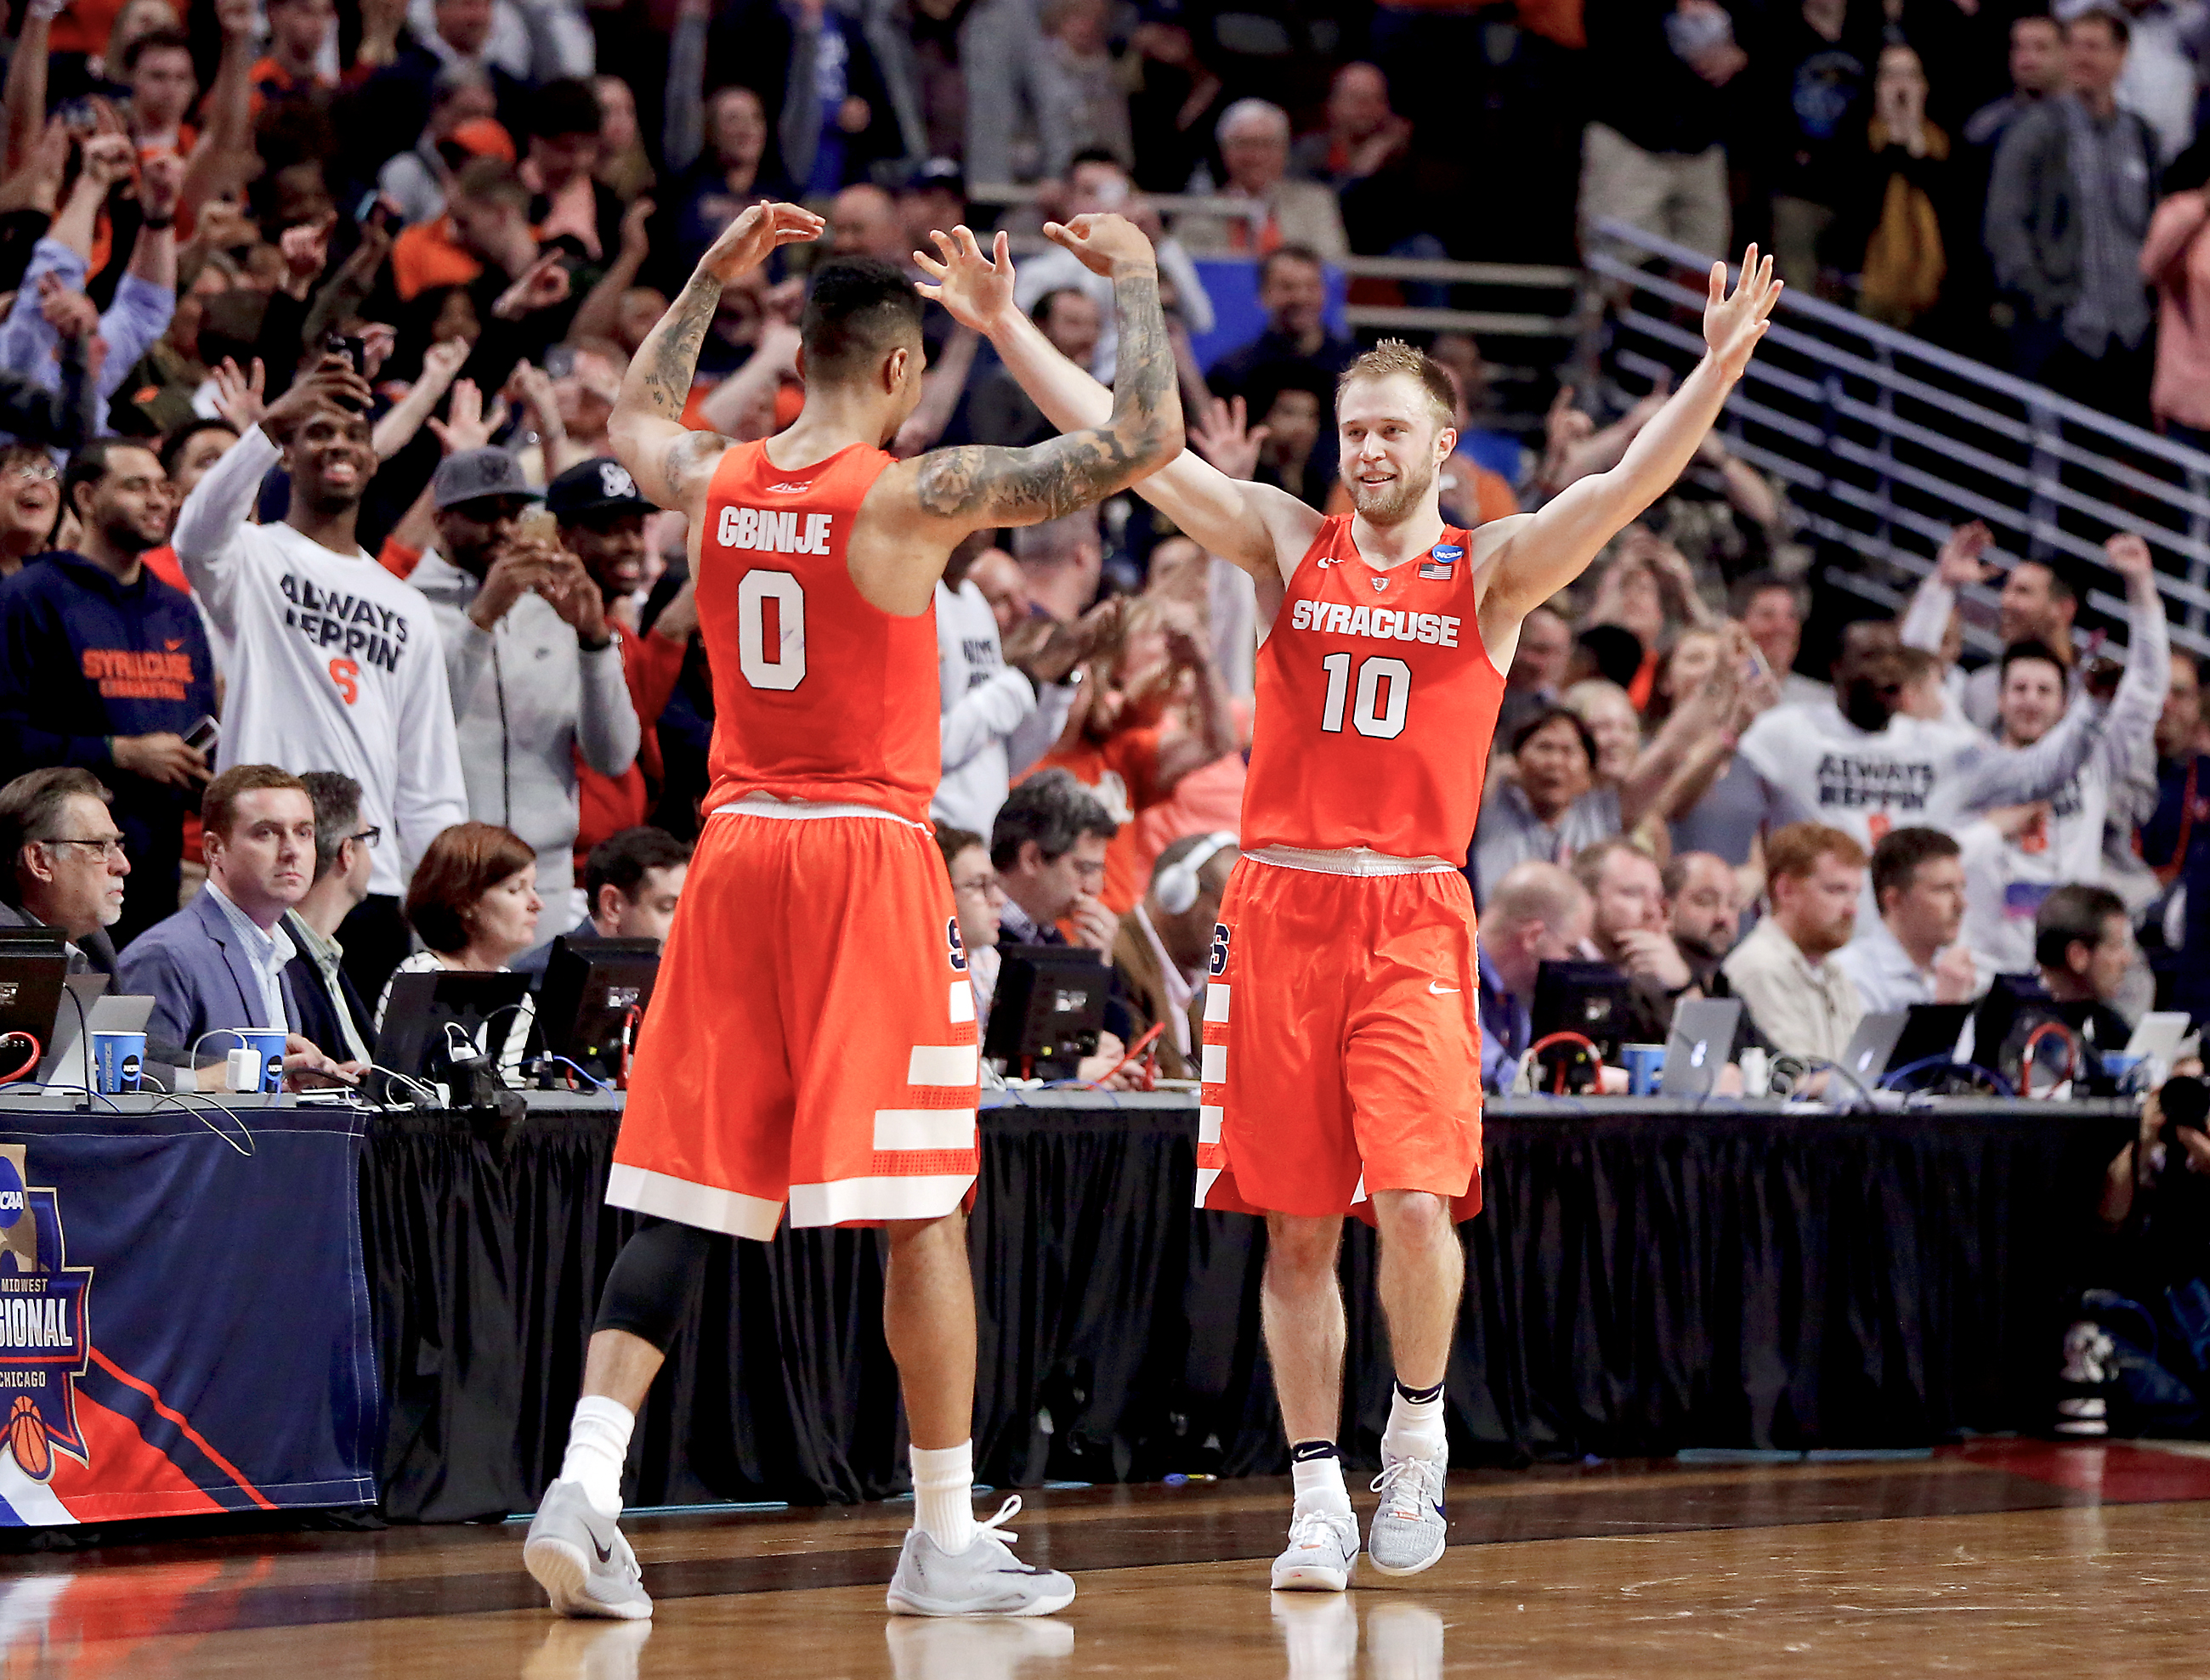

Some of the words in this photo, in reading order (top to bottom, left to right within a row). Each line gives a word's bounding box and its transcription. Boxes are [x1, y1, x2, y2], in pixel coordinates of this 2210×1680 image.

[717, 506, 833, 555] GBINIJE
[280, 574, 407, 643] ALWAYS
[738, 568, 807, 692] 0
[1292, 599, 1461, 648] SYRACUSE
[1322, 652, 1413, 740] 10
[0, 1191, 24, 1210] CAA
[1, 1278, 48, 1293] MIDWEST
